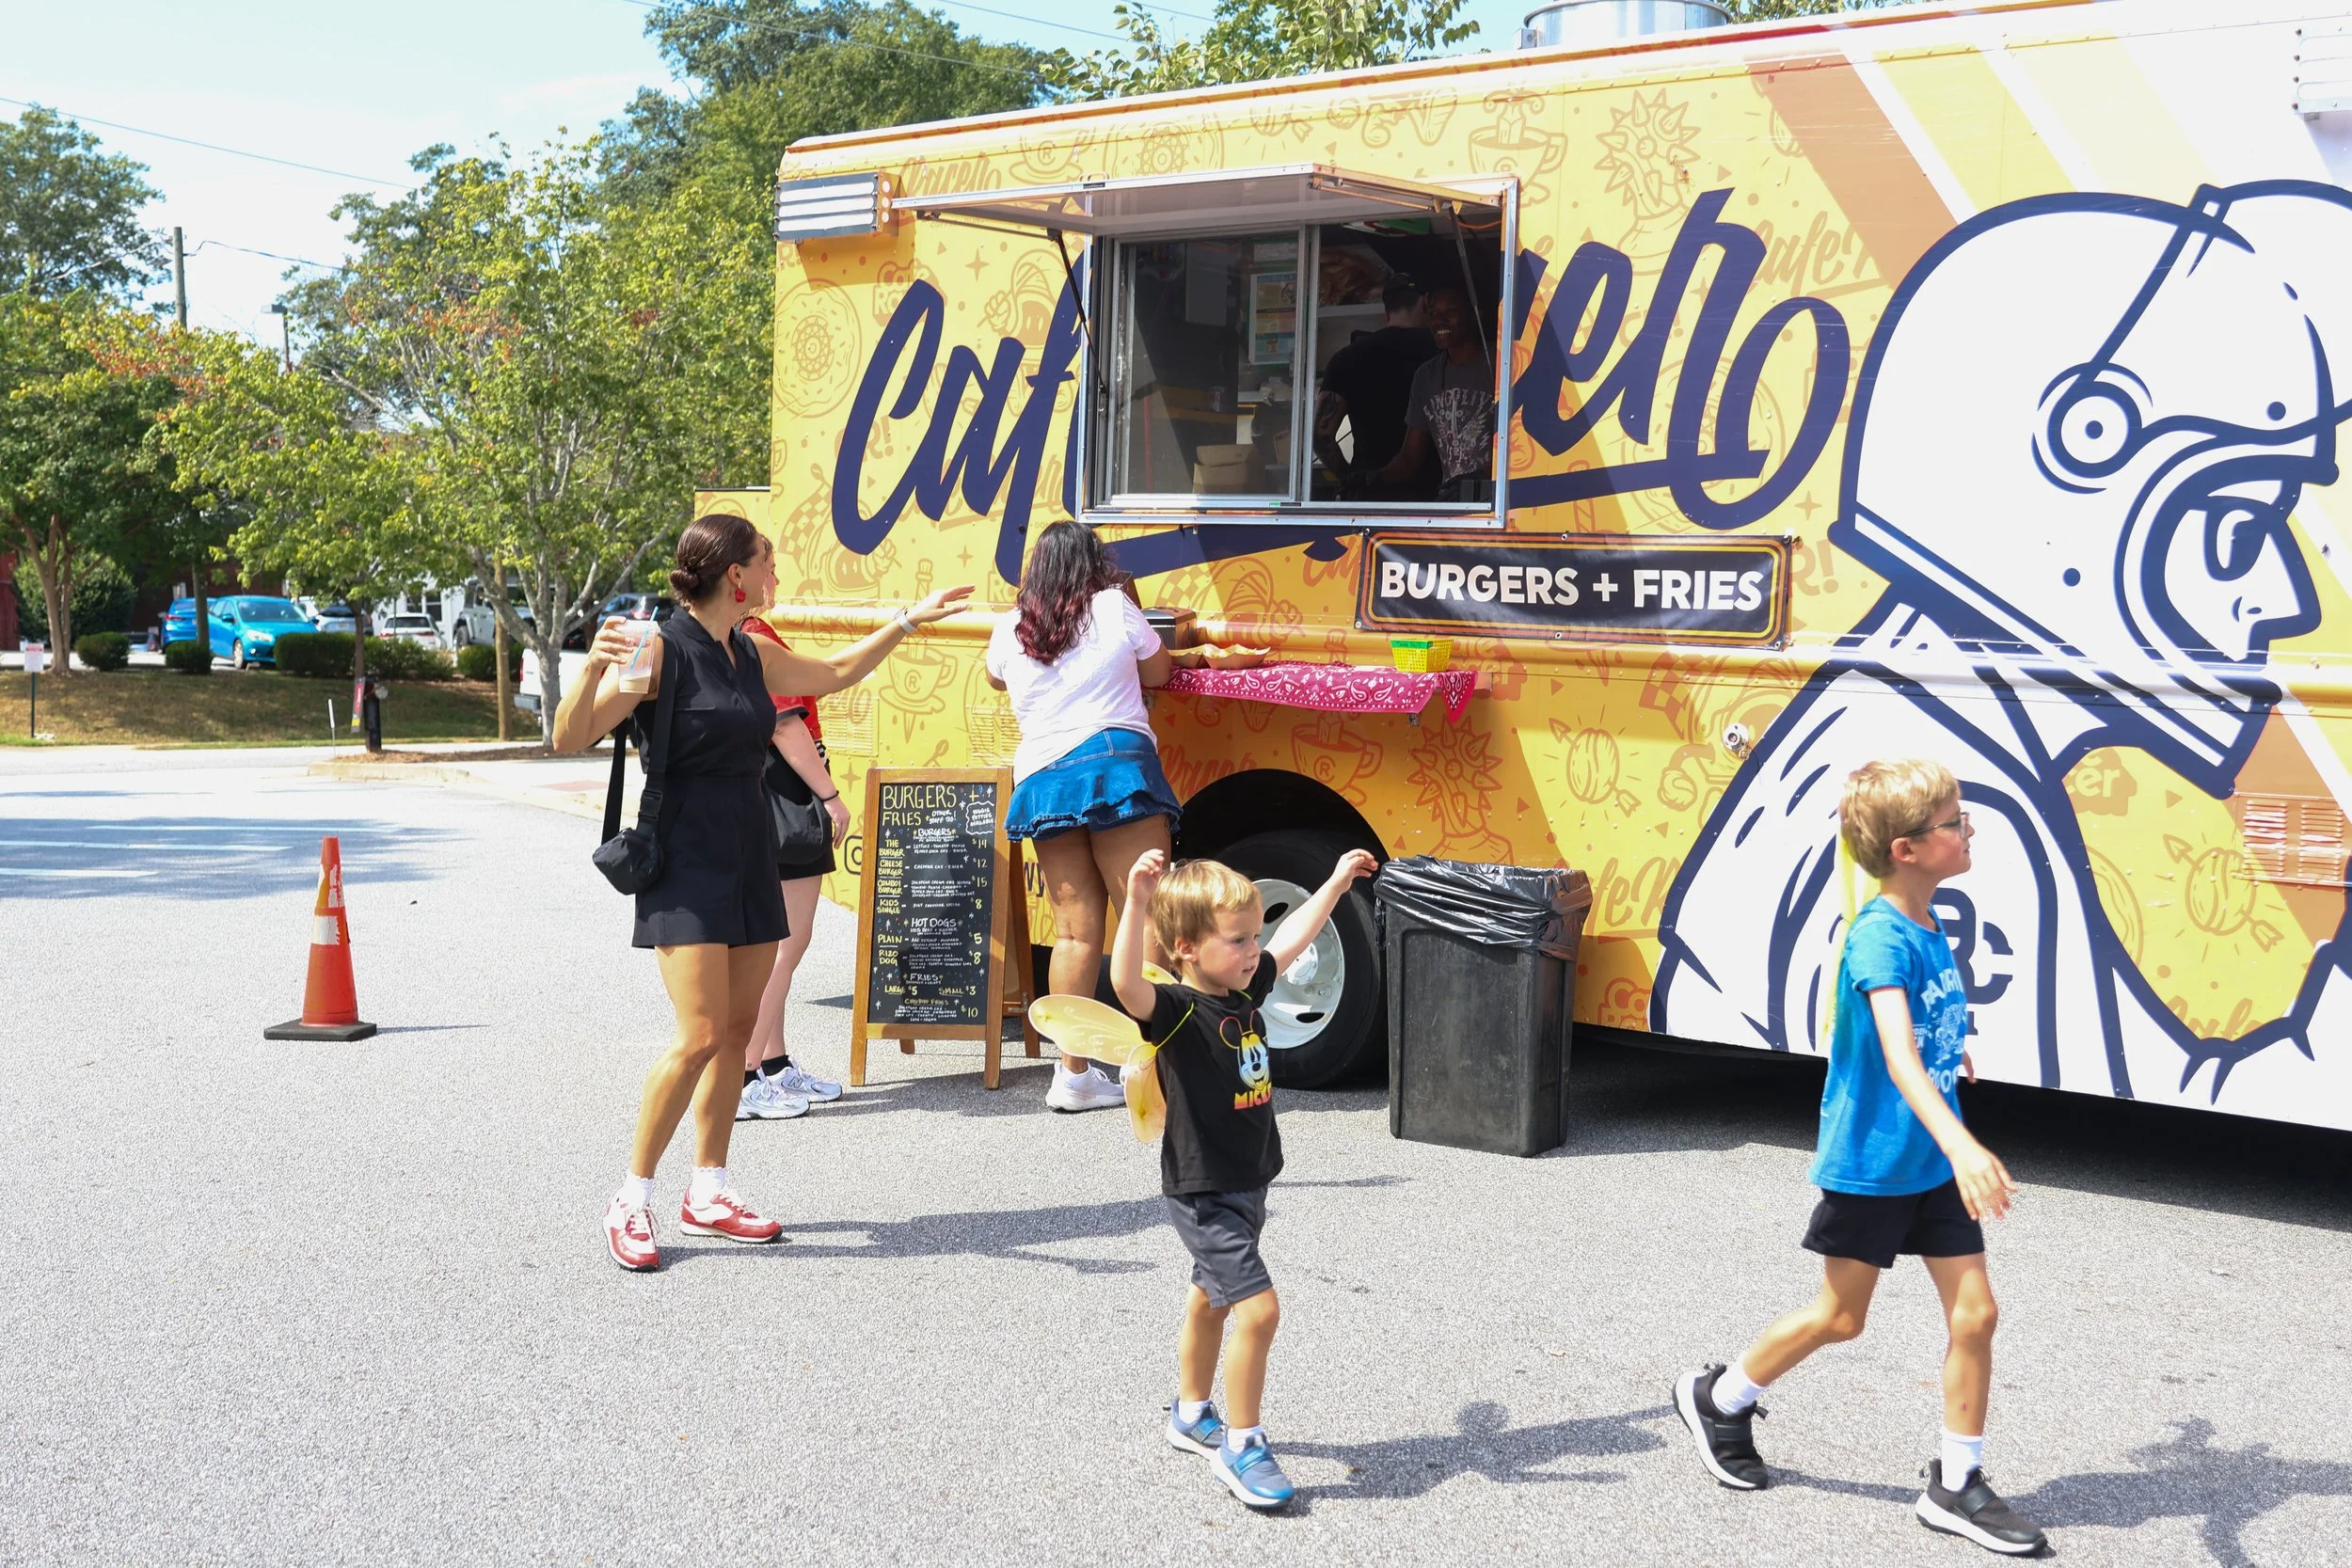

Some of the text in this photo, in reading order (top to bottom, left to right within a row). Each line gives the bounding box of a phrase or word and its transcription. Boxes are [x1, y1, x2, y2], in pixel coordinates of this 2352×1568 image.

[1380, 562, 1764, 611] BURGERS + FRIES
[882, 785, 957, 810] BURGERS
[882, 812, 922, 827] FRIES
[917, 828, 952, 836] BURGERS
[885, 839, 899, 847] THE
[879, 848, 905, 857] BURGER
[880, 860, 903, 868] CHEESE
[878, 868, 904, 877] BURGER
[880, 898, 899, 907] KIDS
[877, 907, 901, 915] SINGLE
[912, 918, 957, 928] HOT DOGS
[878, 934, 902, 943] PLAIN
[880, 958, 898, 967] DOG
[884, 985, 906, 994] LARGE
